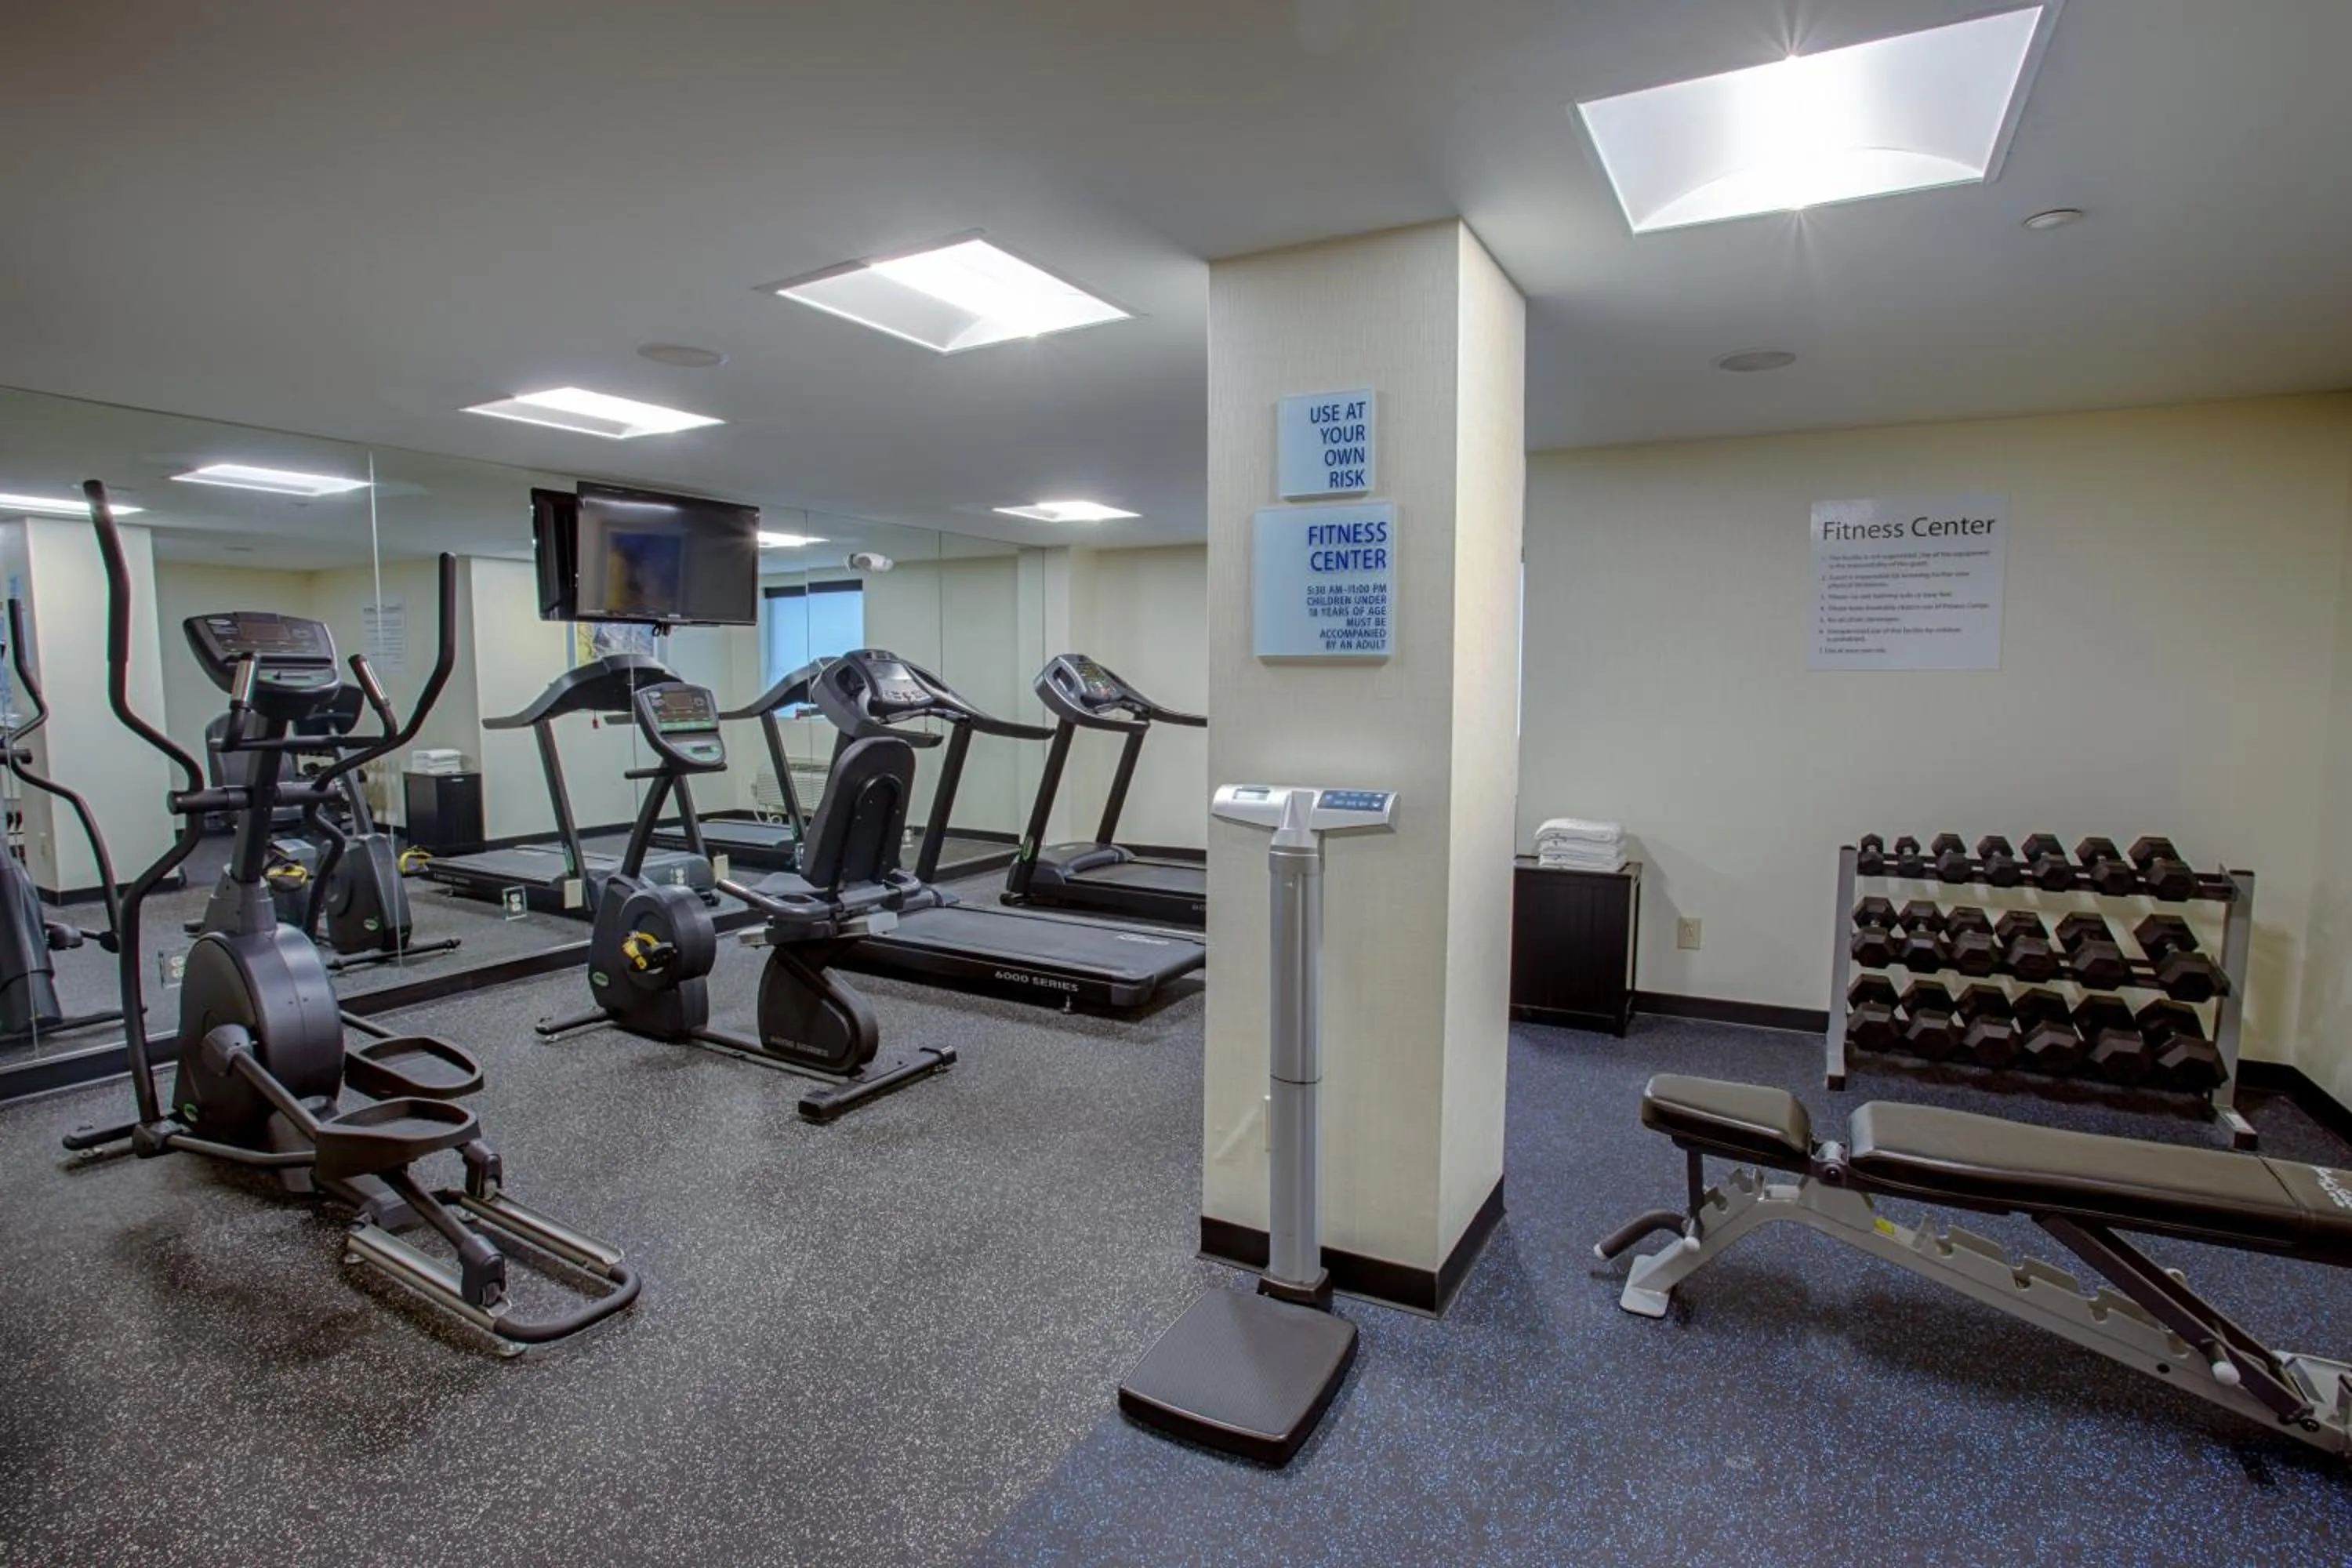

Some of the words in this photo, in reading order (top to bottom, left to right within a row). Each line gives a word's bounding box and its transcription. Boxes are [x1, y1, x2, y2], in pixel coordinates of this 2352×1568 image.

[1310, 404, 1340, 424] USE
[1346, 401, 1366, 419] AT
[1319, 424, 1365, 445] YOUR
[1324, 446, 1365, 466] OWN
[1329, 468, 1365, 488] RISK
[1308, 521, 1387, 546] FITNESS
[1823, 521, 1904, 541] Fitness
[1911, 516, 1996, 537] Center
[1310, 548, 1386, 572] CENTER
[1373, 583, 1387, 593] PM
[1306, 596, 1352, 606] CHILDREN
[1354, 594, 1387, 605] UNDER
[1320, 607, 1349, 617] YEARS
[1352, 606, 1365, 615] OF
[1367, 605, 1387, 615] AGE
[1346, 617, 1372, 626] MUST
[1374, 617, 1387, 626] BE
[1319, 628, 1387, 639] ACCOMPANIED
[1326, 640, 1337, 650] BY
[1340, 640, 1353, 650] AN
[1356, 639, 1386, 650] ADULT
[995, 969, 1029, 984] 6000
[1033, 975, 1080, 993] SERIES
